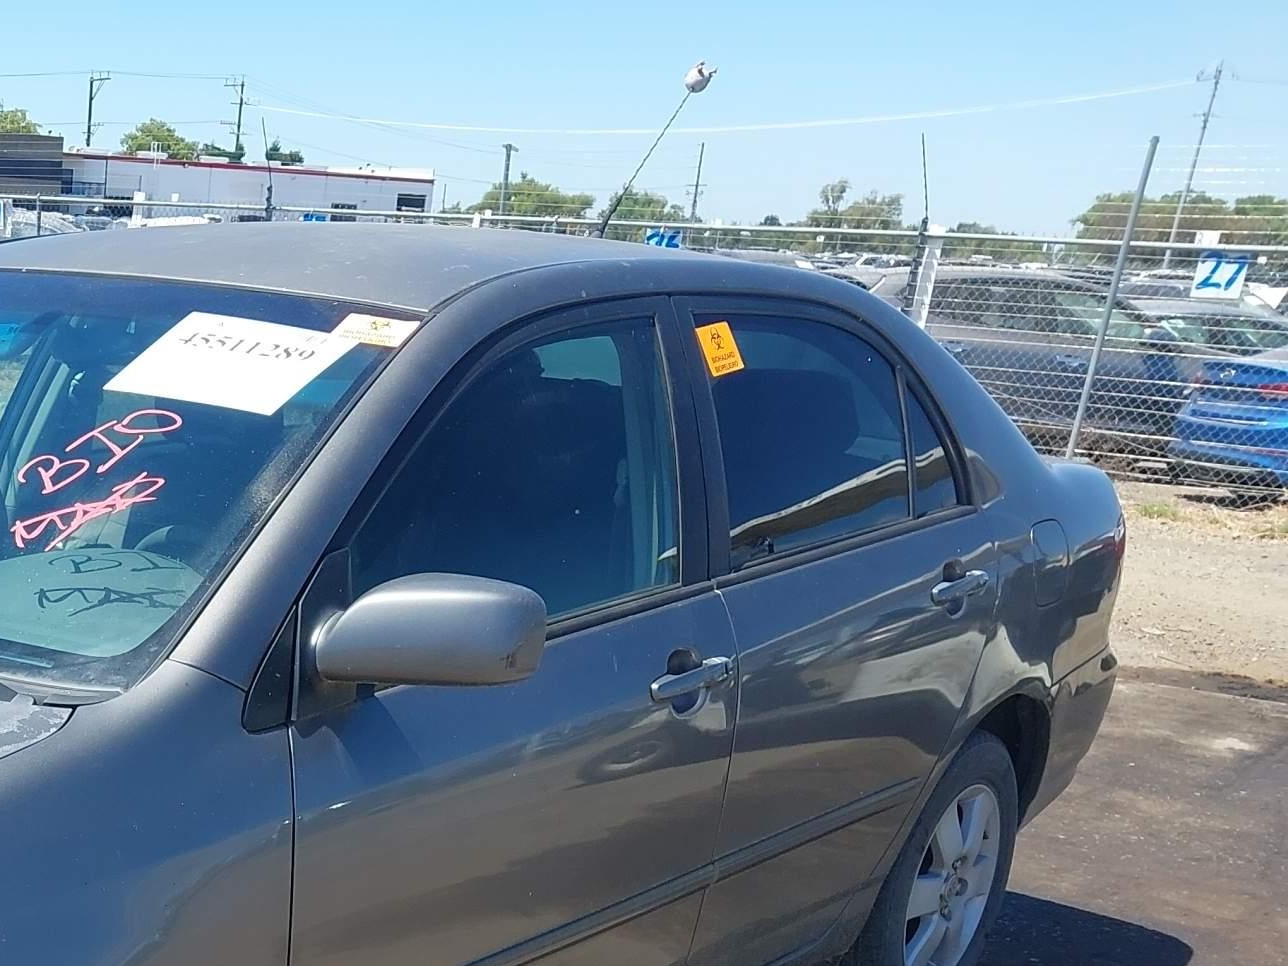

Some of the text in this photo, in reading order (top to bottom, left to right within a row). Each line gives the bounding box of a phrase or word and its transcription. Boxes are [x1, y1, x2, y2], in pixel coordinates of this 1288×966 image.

[1195, 250, 1249, 292] 27
[178, 331, 317, 361] 45511289
[17, 408, 184, 495] BIO
